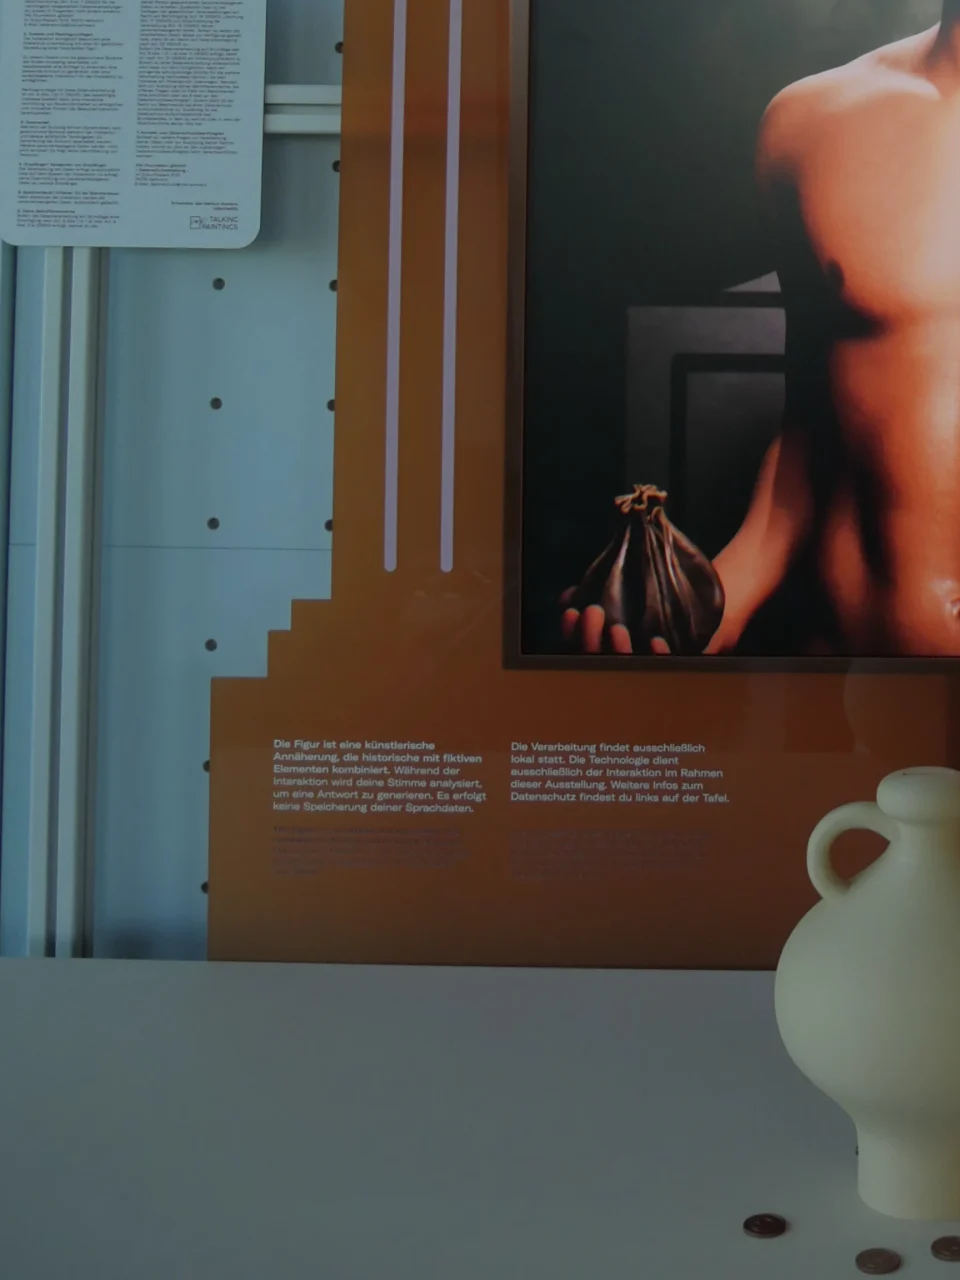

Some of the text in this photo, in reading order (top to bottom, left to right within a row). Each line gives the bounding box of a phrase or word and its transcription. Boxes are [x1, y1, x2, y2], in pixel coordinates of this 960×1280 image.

[274, 740, 435, 750] Die Figur ist eine künstlerische
[511, 742, 705, 753] Die Verarbeitung findet ausschließlich
[273, 752, 482, 763] Annäherung, die historische mit fiktiven
[511, 755, 679, 766] lokal statt. Die Technologie dient
[273, 765, 460, 775] Elementen kombiniert. Während der
[511, 767, 723, 778] ausschließlich der Interaktion im Rahmen
[273, 777, 328, 785] Interaktion
[332, 778, 352, 786] wird
[356, 778, 384, 786] deine
[388, 778, 426, 787] Stimme
[511, 780, 541, 789] dieser
[545, 780, 607, 791] Ausstellung.
[611, 781, 649, 789] Weitere
[653, 781, 678, 790] Infos
[292, 790, 314, 798] eine
[317, 790, 358, 799] Antwort
[377, 791, 433, 801] generieren.
[437, 792, 449, 800] Es
[453, 792, 486, 802] erfolgt
[511, 792, 729, 803] Datenschutz findest du links auf der Tafel.
[273, 802, 474, 814] keine Speicherung deiner Sprachdaten.
